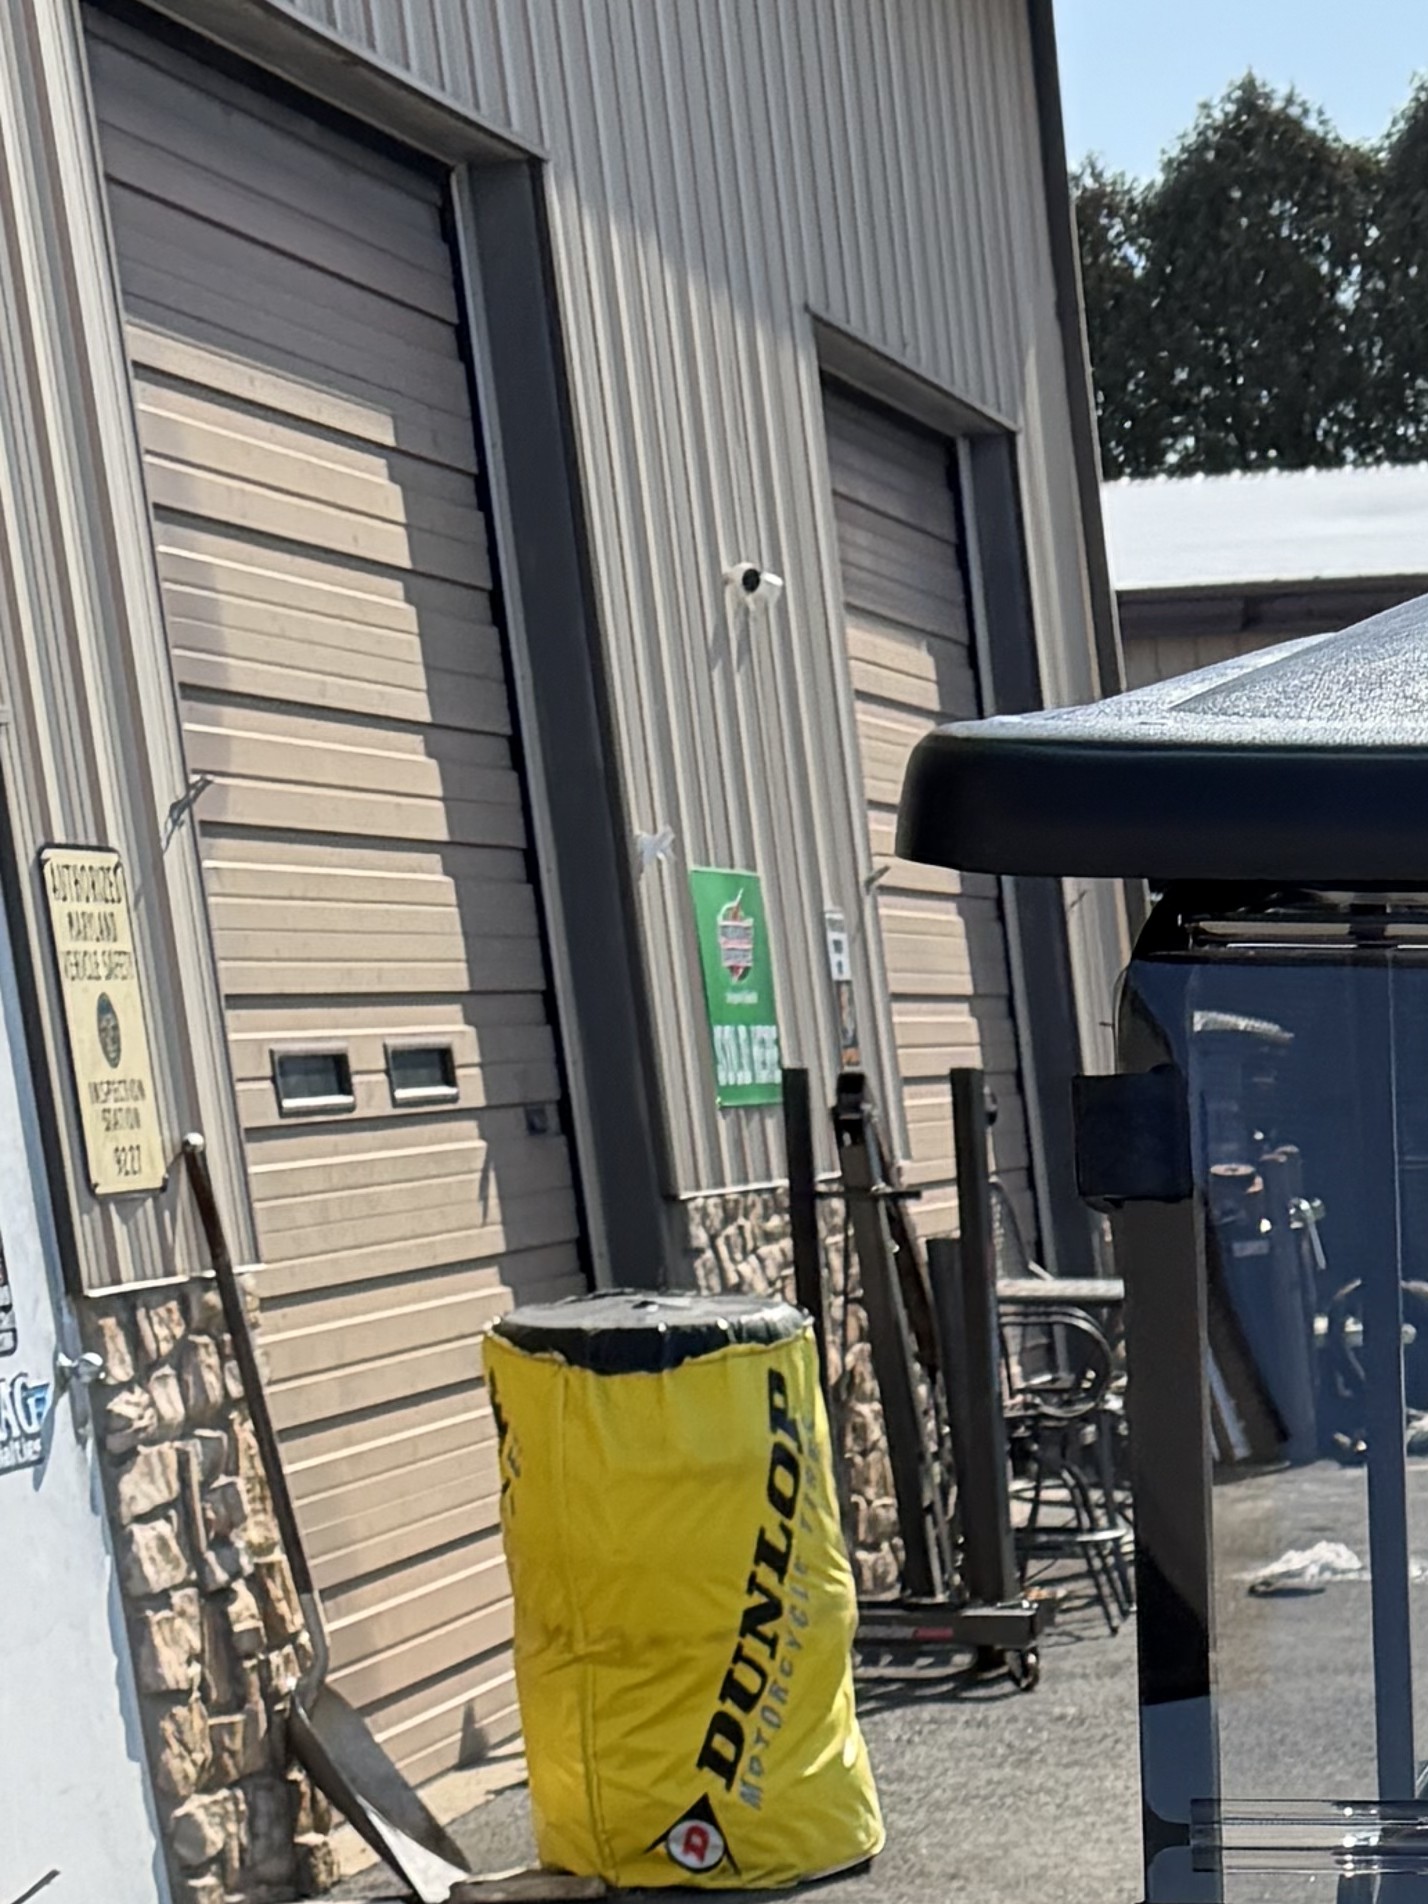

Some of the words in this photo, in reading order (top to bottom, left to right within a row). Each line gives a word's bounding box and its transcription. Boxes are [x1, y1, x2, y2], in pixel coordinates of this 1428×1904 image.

[51, 863, 122, 904] AUTHORIZED
[66, 911, 118, 943] MARYLAND
[695, 1367, 804, 1793] DUNLOP
